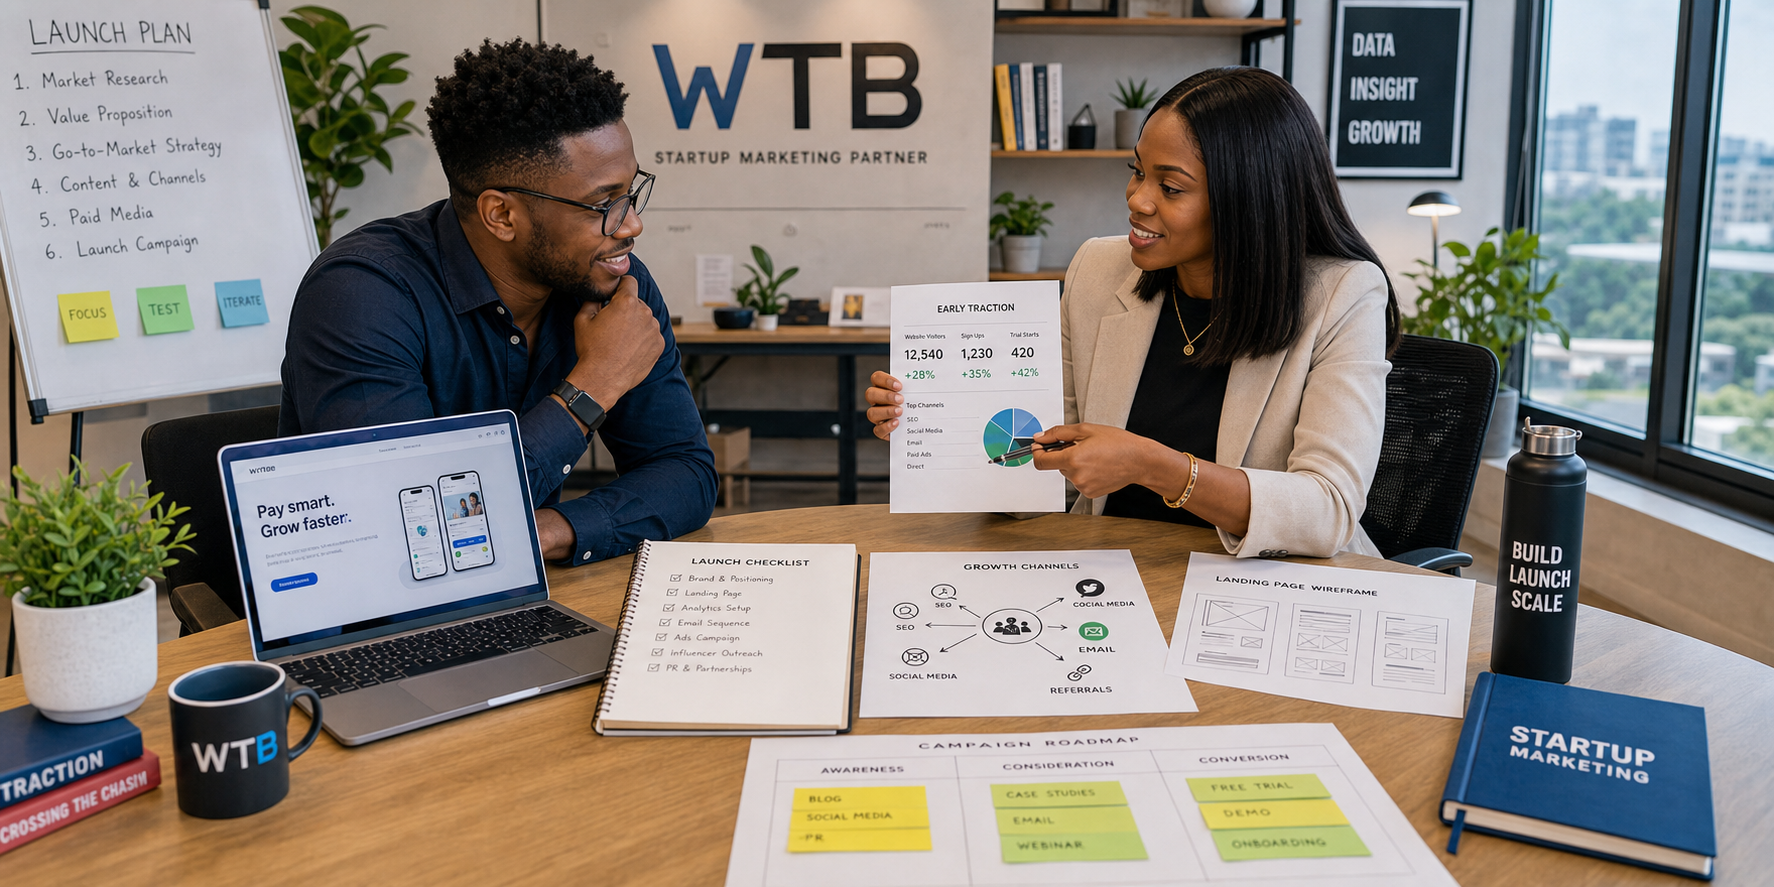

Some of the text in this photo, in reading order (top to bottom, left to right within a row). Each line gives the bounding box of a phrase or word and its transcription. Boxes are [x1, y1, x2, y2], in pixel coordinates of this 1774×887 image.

[29, 19, 192, 46] LAUNCH PLAN
[1352, 32, 1395, 57] DATA
[13, 69, 169, 91] 1. Market Research
[652, 42, 922, 129] WTB
[1350, 77, 1418, 101] INSIGHT
[18, 104, 173, 127] 2. Value Proposition
[1347, 120, 1421, 145] GROWTH
[25, 137, 223, 162] 3. Go-to-Market Strategy
[655, 151, 928, 164] STARTUP MARKETING PARTNER
[31, 168, 207, 195] 4. Content & Channels
[39, 206, 154, 228] 5. Paid Media
[45, 235, 199, 260] 6. Launch Campaign
[222, 295, 262, 308] ITERATE
[68, 307, 107, 321] FOCUS
[147, 302, 181, 317] TEST
[937, 303, 1015, 314] EARLY TRACTION
[905, 349, 944, 361] 12,540
[961, 348, 993, 361] 1,230
[1011, 347, 1035, 358] 420
[905, 370, 936, 380] +28%
[962, 369, 992, 379] +35%
[1011, 368, 1039, 377] +42%
[257, 495, 335, 519] Pay smart.
[261, 522, 300, 538] Grow
[1512, 540, 1563, 565] BUILD
[691, 558, 810, 567] LAUNCH CHECKLIST
[1021, 562, 1080, 570] CHANNELS
[689, 575, 774, 584] Brand & Positioning
[1509, 564, 1571, 588] LAUNCH
[1216, 575, 1378, 597] LANDING PAGE WIREFRAME
[685, 590, 742, 599] Landing Page
[1511, 589, 1563, 613] SCALE
[681, 605, 751, 614] Analytics Setup
[678, 619, 750, 628] Email Sequence
[696, 635, 740, 644] Campaign
[1079, 646, 1116, 654] EMAIL
[696, 665, 753, 674] Partnerships
[1050, 686, 1113, 694] REFERRALS
[919, 736, 1140, 750] CAMPAIGN ROADMAP
[1509, 725, 1656, 767] STARTUP
[191, 729, 278, 773] WTB
[1199, 754, 1290, 764] CONVERSION
[1509, 745, 1650, 784] MARKETING
[821, 766, 905, 774] AWARENESS
[1003, 761, 1115, 771] CONSIDERATION
[0, 750, 104, 802] TRACTION
[1211, 782, 1294, 792] FREE TRIAL
[809, 795, 842, 804] BLOG
[1006, 789, 1096, 799] CASE STUDIES
[0, 802, 70, 844] CROSSING
[72, 790, 99, 813] THE
[807, 811, 893, 822] SOCIAL MEDIA
[1224, 809, 1271, 818] DEMO
[1013, 816, 1056, 826] EMAIL
[1017, 841, 1085, 852] WEBINAR
[1232, 838, 1327, 850] ONBOARDING
